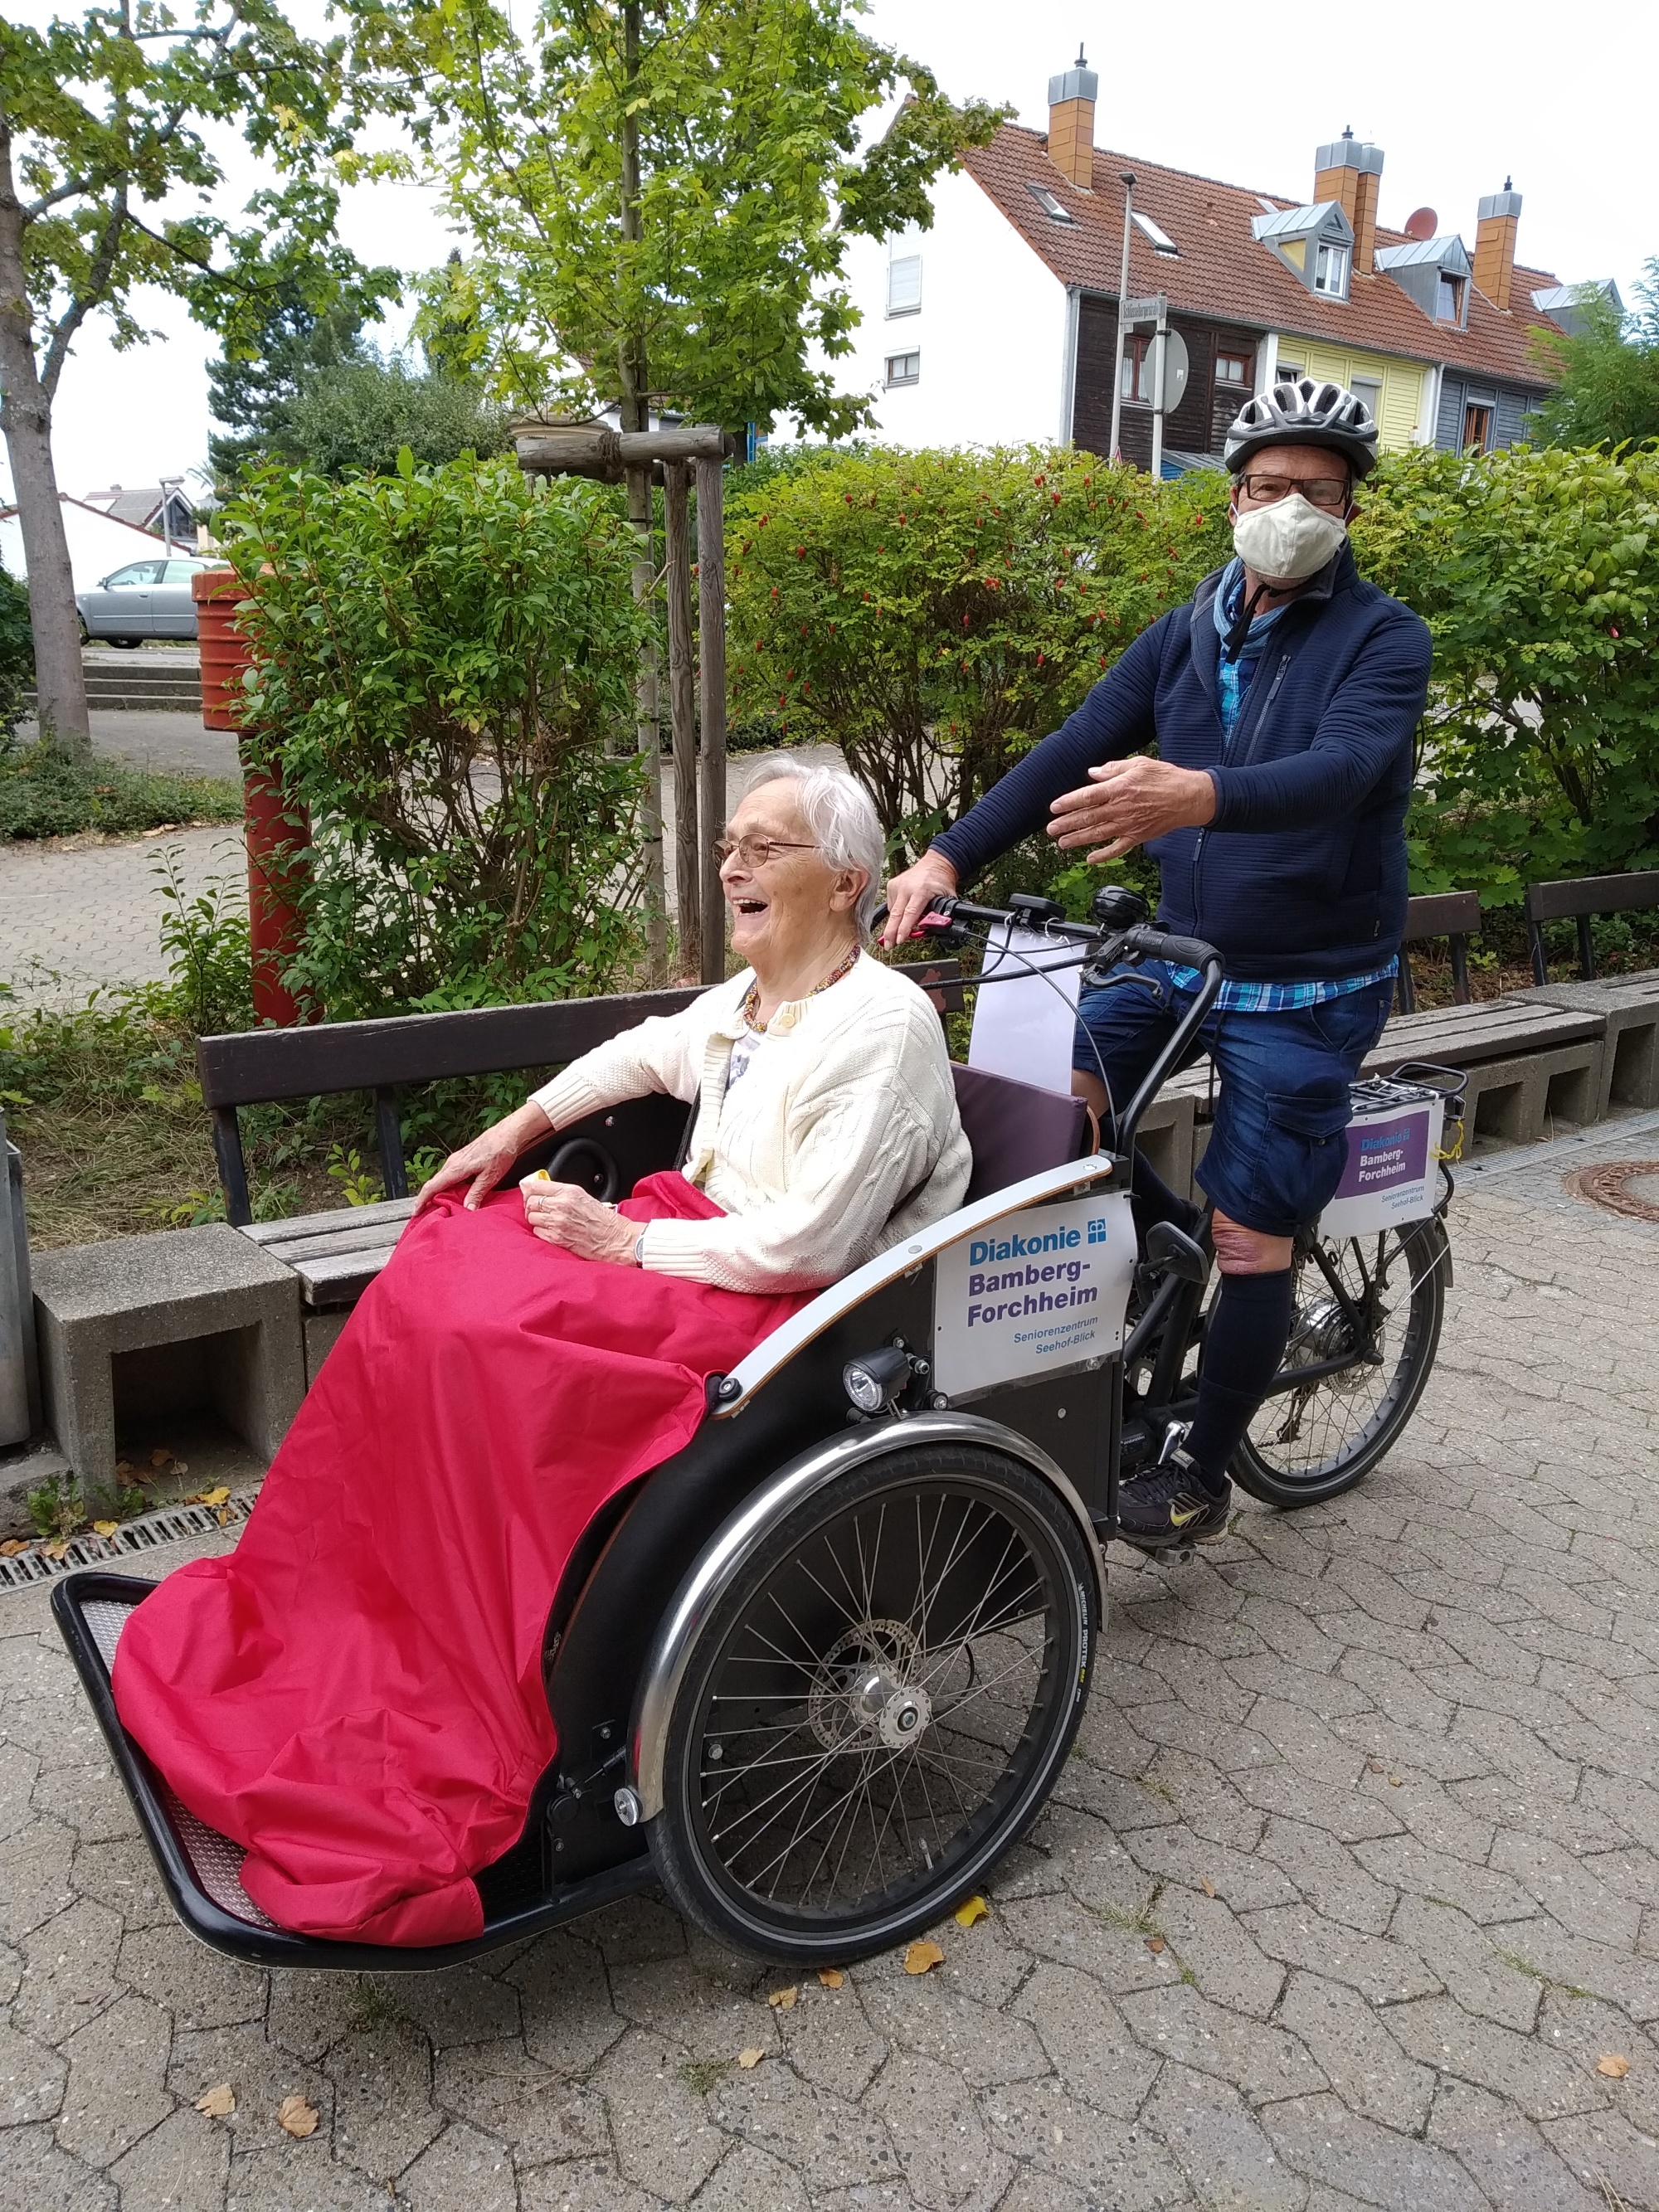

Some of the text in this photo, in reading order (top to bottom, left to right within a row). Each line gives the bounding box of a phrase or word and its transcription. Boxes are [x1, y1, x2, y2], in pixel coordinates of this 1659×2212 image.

[1123, 301, 1159, 318] Schlüsselbergerstraß
[1361, 1132, 1402, 1151] Diakonie
[1360, 1149, 1404, 1167] Bamberg-
[1358, 1162, 1406, 1183] Forchheim
[1381, 1185, 1425, 1203] Seniorenzentrum
[1391, 1195, 1423, 1209] Seehof-Blick
[970, 1226, 1082, 1266] Diakonie
[969, 1261, 1091, 1296] Bamberg-
[967, 1286, 1097, 1327] Forchheim
[1014, 1315, 1098, 1343] Seniorenzentrum
[1035, 1330, 1095, 1354] Seehof-Blick
[1080, 1590, 1088, 1626] MICHELIN
